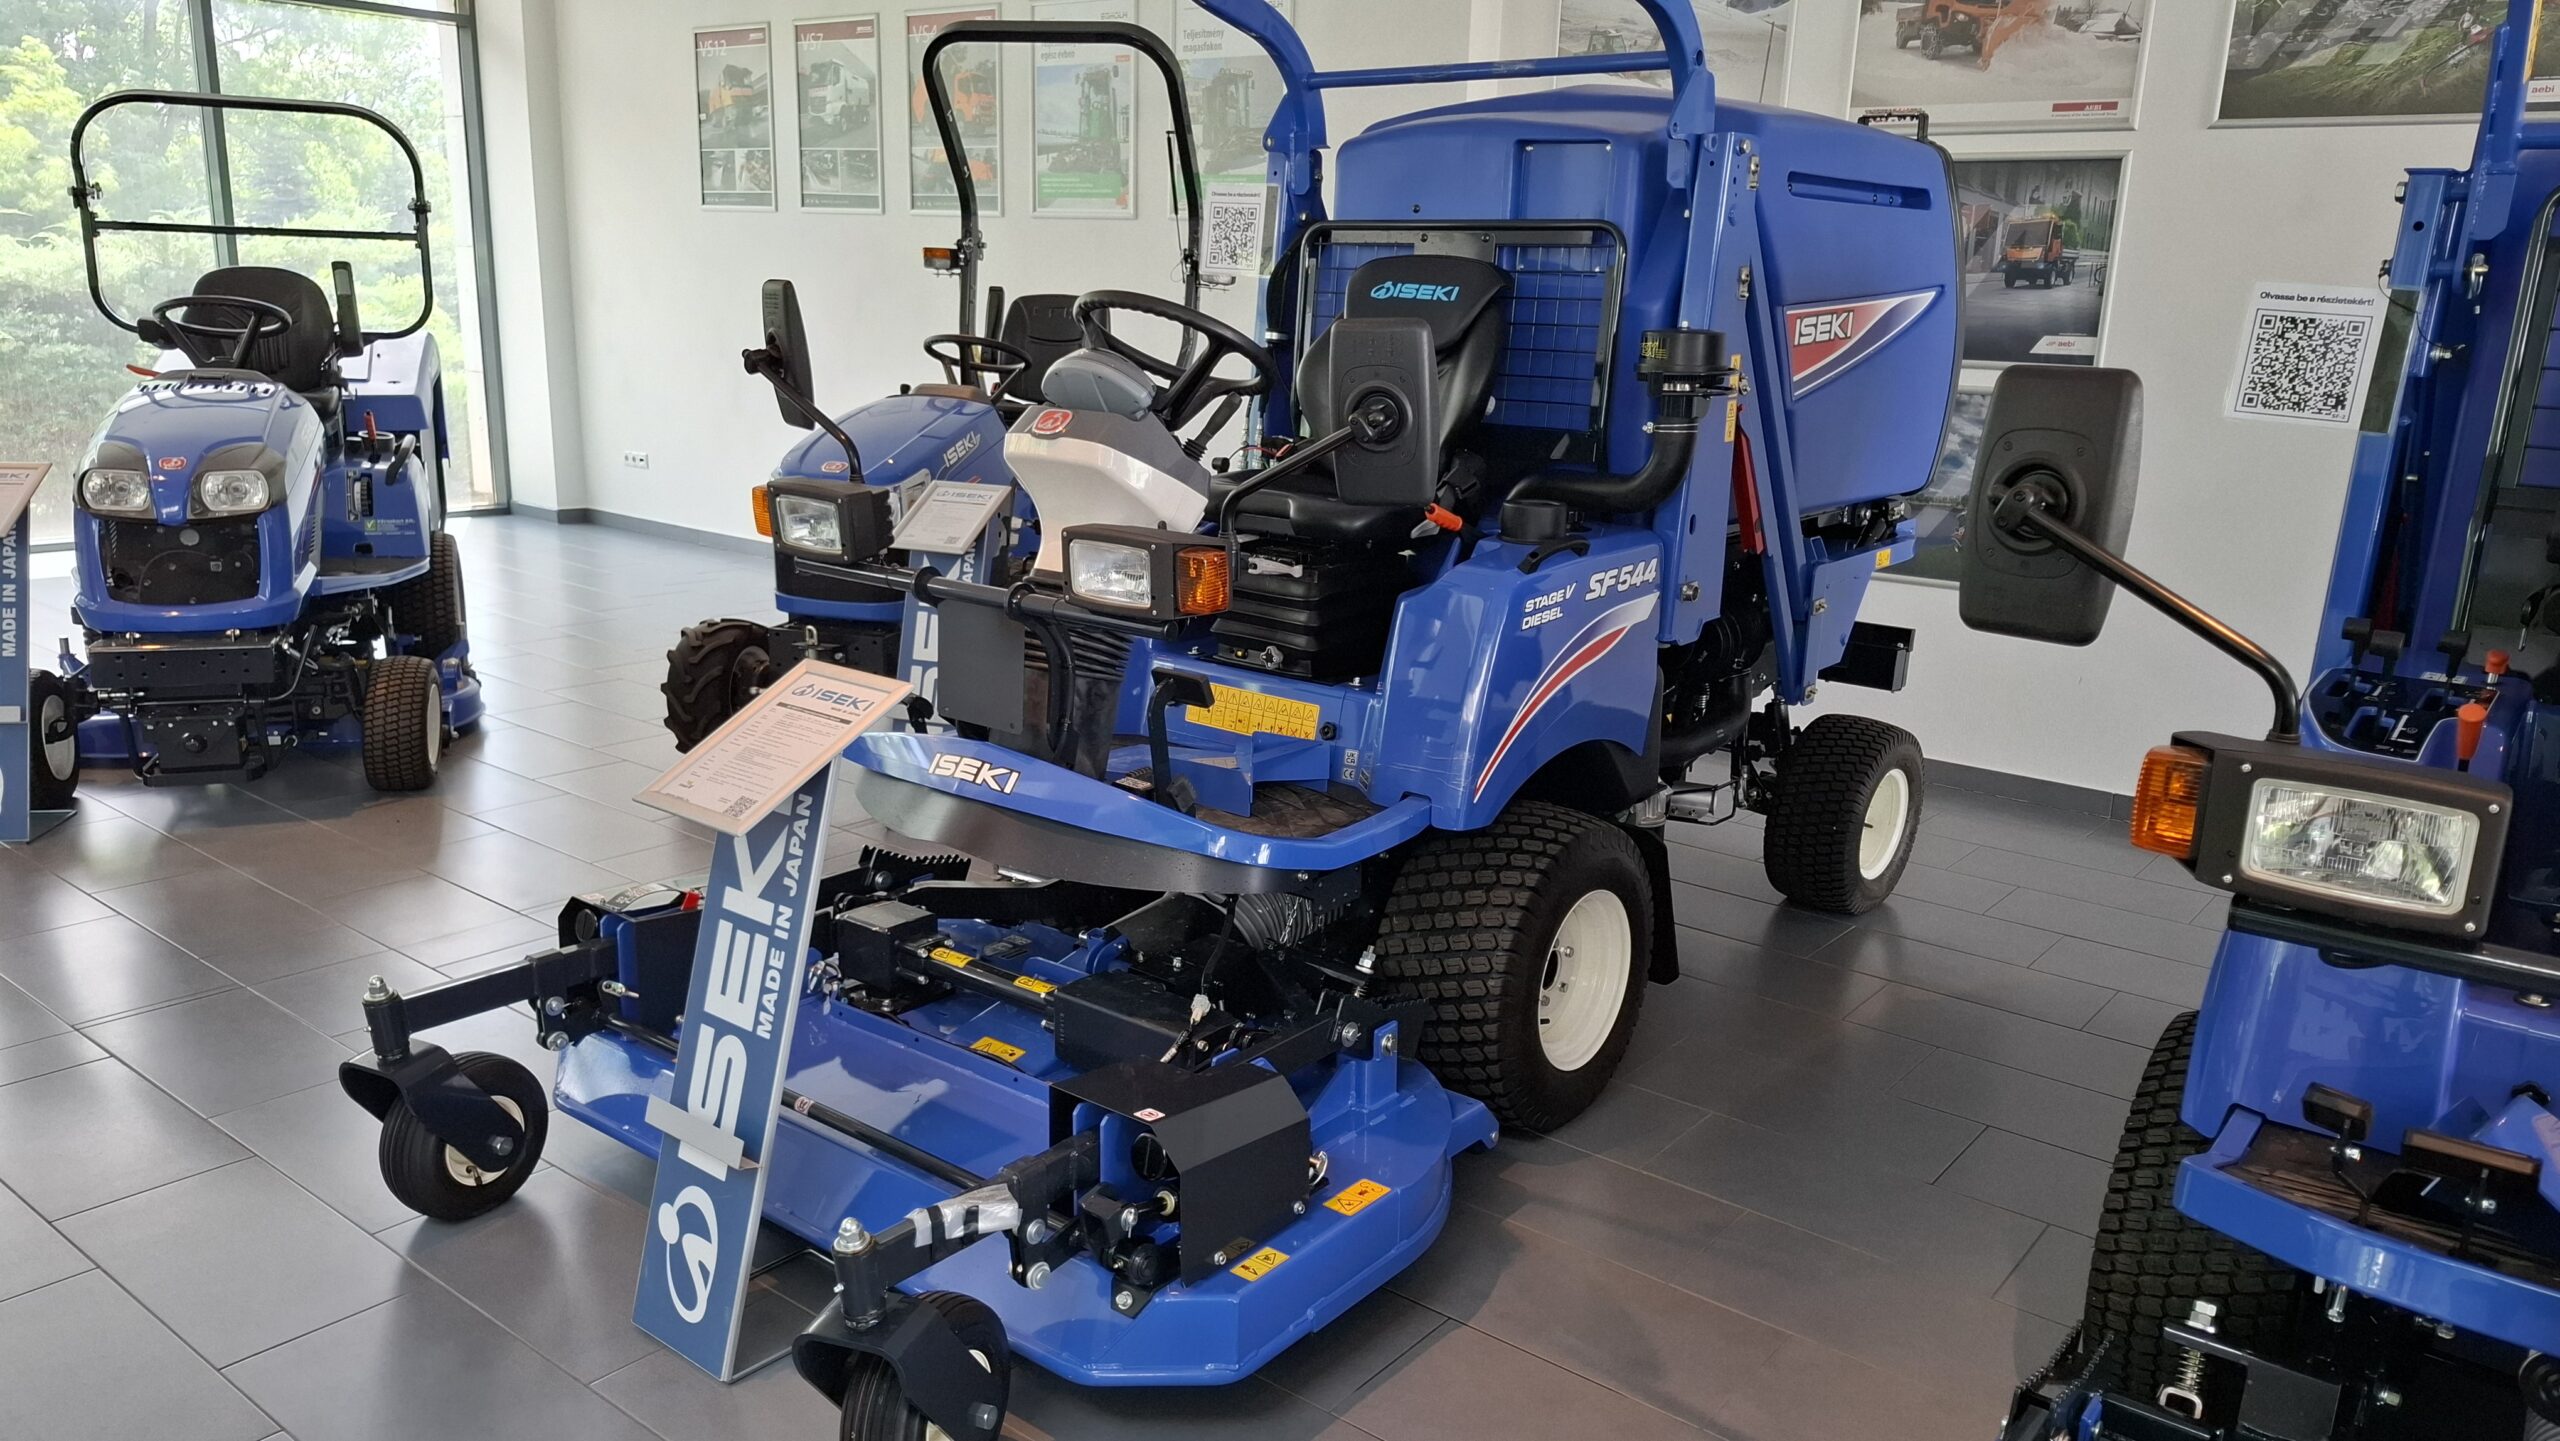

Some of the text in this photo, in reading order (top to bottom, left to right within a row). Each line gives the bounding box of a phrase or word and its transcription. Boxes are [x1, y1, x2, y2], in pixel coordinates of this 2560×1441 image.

[699, 40, 727, 57] VS12
[801, 33, 823, 50] VS7
[2531, 85, 2555, 94] aebi
[1393, 283, 1460, 301] ISEKI
[1793, 311, 1855, 346] ISEKI
[2058, 340, 2076, 348] aebi
[943, 431, 978, 468] ISEKI
[951, 491, 994, 500] ISEKI
[2, 584, 17, 602] IN
[1521, 606, 1563, 630] DIESEL
[2, 608, 17, 657] MADE
[811, 688, 875, 712] ISEKI
[928, 752, 1021, 795] ISEKI
[756, 793, 813, 1040] MADE IN JAPAN
